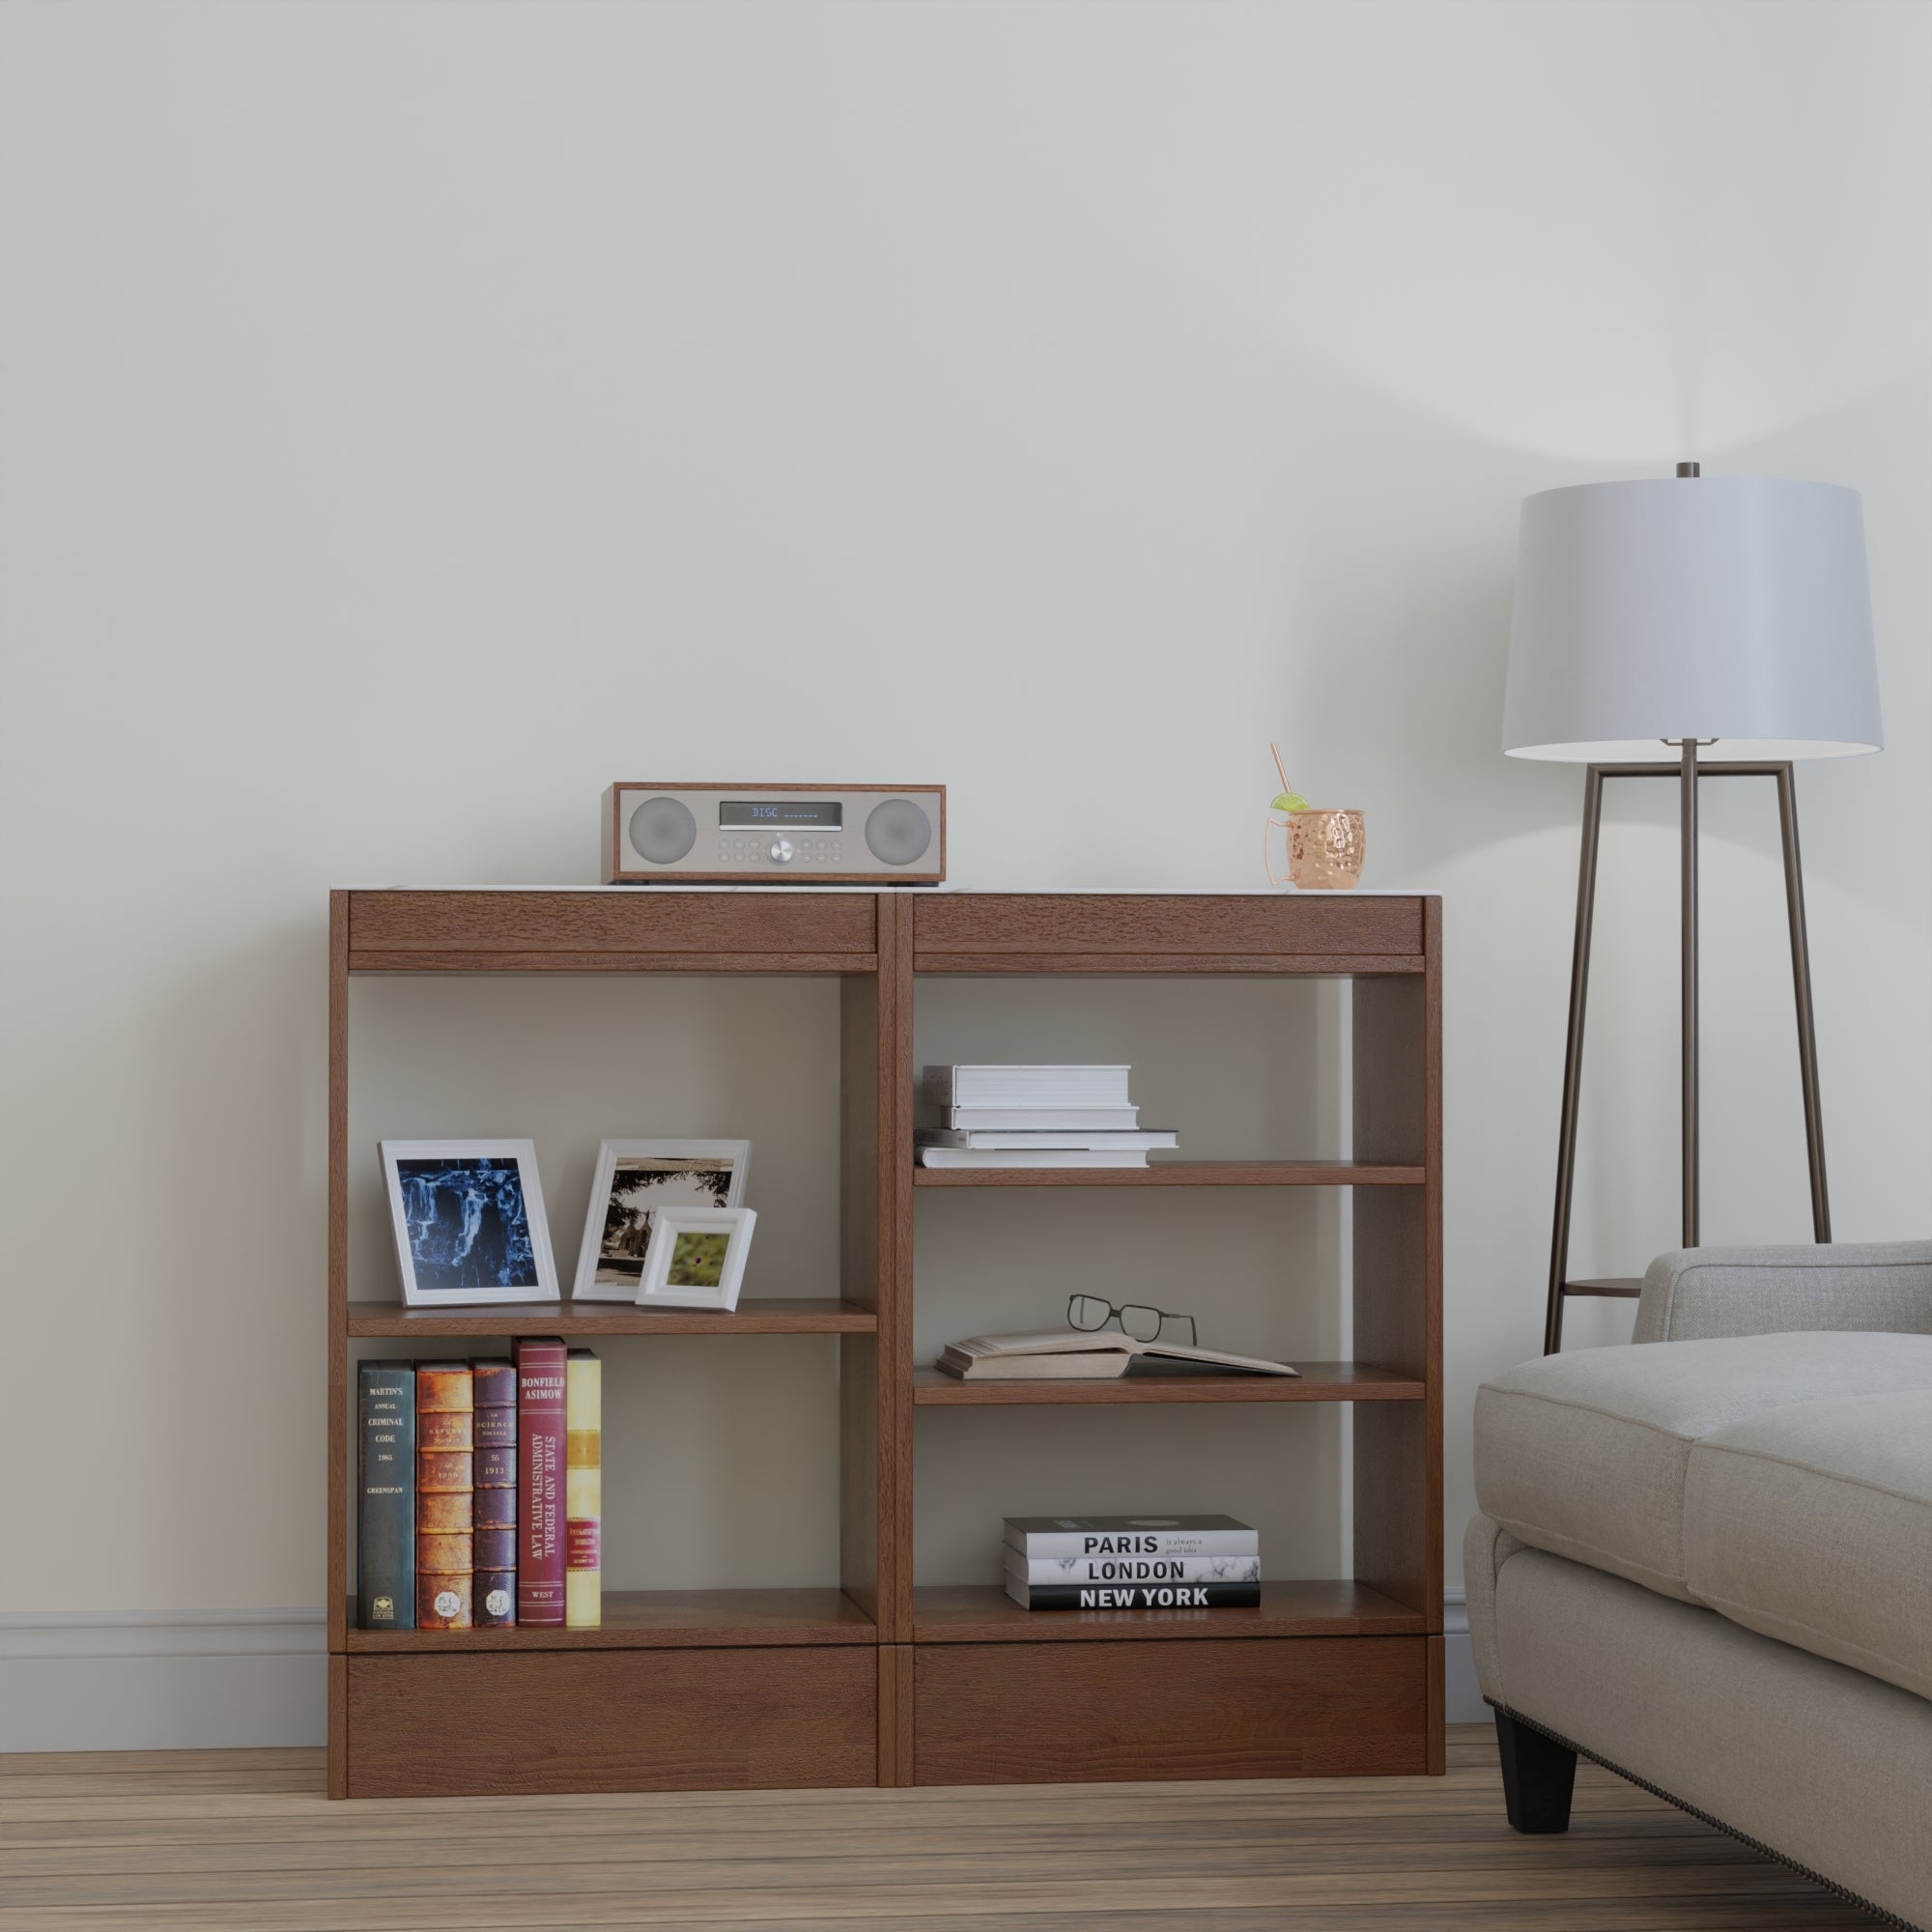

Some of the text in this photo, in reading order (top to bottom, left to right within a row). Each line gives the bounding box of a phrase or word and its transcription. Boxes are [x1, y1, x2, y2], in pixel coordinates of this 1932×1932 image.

[752, 808, 779, 817] DISC
[522, 1377, 565, 1388] BONFIELD
[369, 1387, 403, 1397] MARTIN'S
[525, 1389, 562, 1400] ASIMOW
[368, 1418, 404, 1427] CRIMINAL
[375, 1435, 396, 1443] CODE
[485, 1466, 505, 1475] 1913
[531, 1434, 544, 1560] ADMINISTRATIVE LAW
[544, 1435, 556, 1557] STATE AND FEDERAL
[1084, 1536, 1159, 1554] PARIS
[1174, 1538, 1197, 1547] always
[1165, 1547, 1182, 1555] good
[1089, 1561, 1184, 1580] LONDON
[1080, 1587, 1209, 1607] NEW YORK
